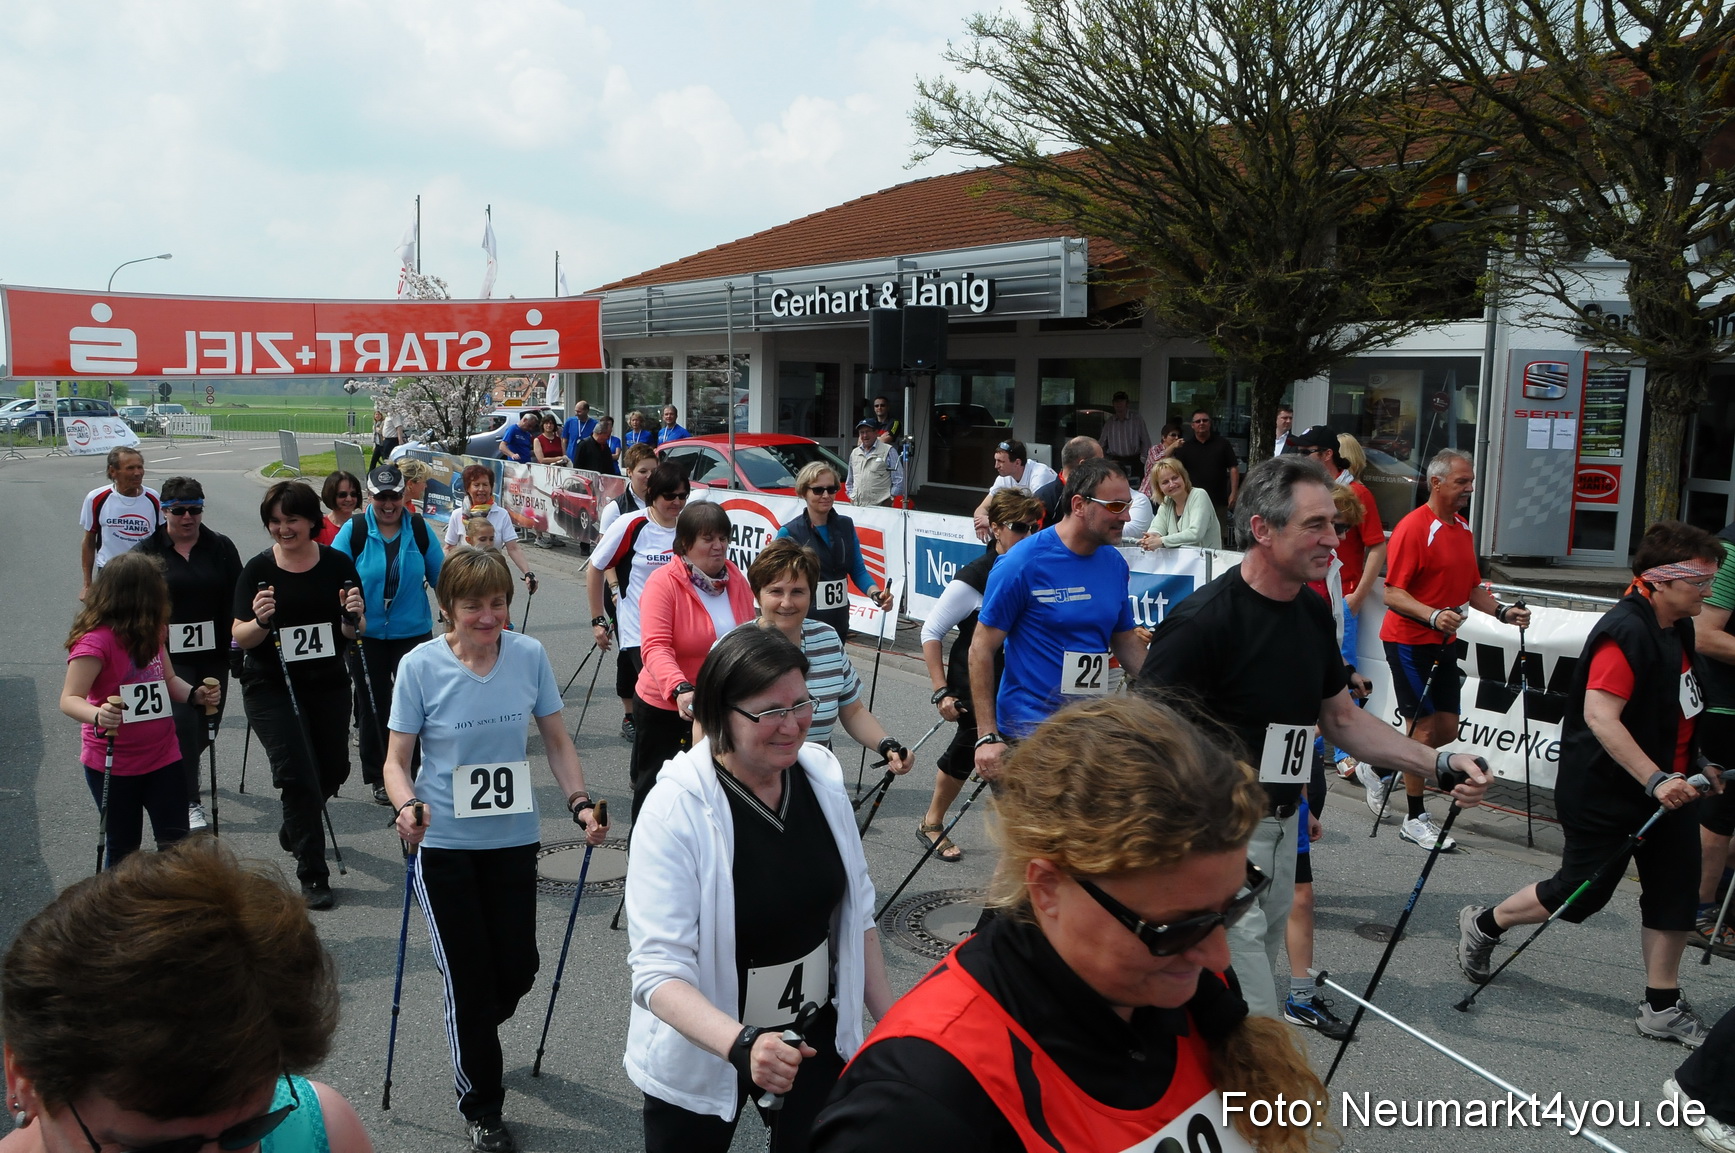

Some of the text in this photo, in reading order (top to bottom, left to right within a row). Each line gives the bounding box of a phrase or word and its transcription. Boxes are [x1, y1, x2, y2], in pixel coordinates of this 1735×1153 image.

[770, 270, 993, 317] Gerhart & Jänig
[1514, 409, 1574, 419] SEAT
[106, 518, 144, 526] GERHART
[729, 524, 765, 549] ART
[646, 554, 672, 562] GERH
[825, 582, 843, 606] 63
[849, 604, 879, 620] EAT
[182, 624, 204, 648] 21
[293, 626, 323, 656] 24
[1074, 655, 1103, 688] 22
[133, 683, 163, 716] 25
[455, 713, 523, 730] JOY SINCE 1977
[1392, 708, 1561, 762] stwerke
[1281, 728, 1307, 776] 19
[470, 766, 514, 810] 29
[777, 961, 805, 1015] 4
